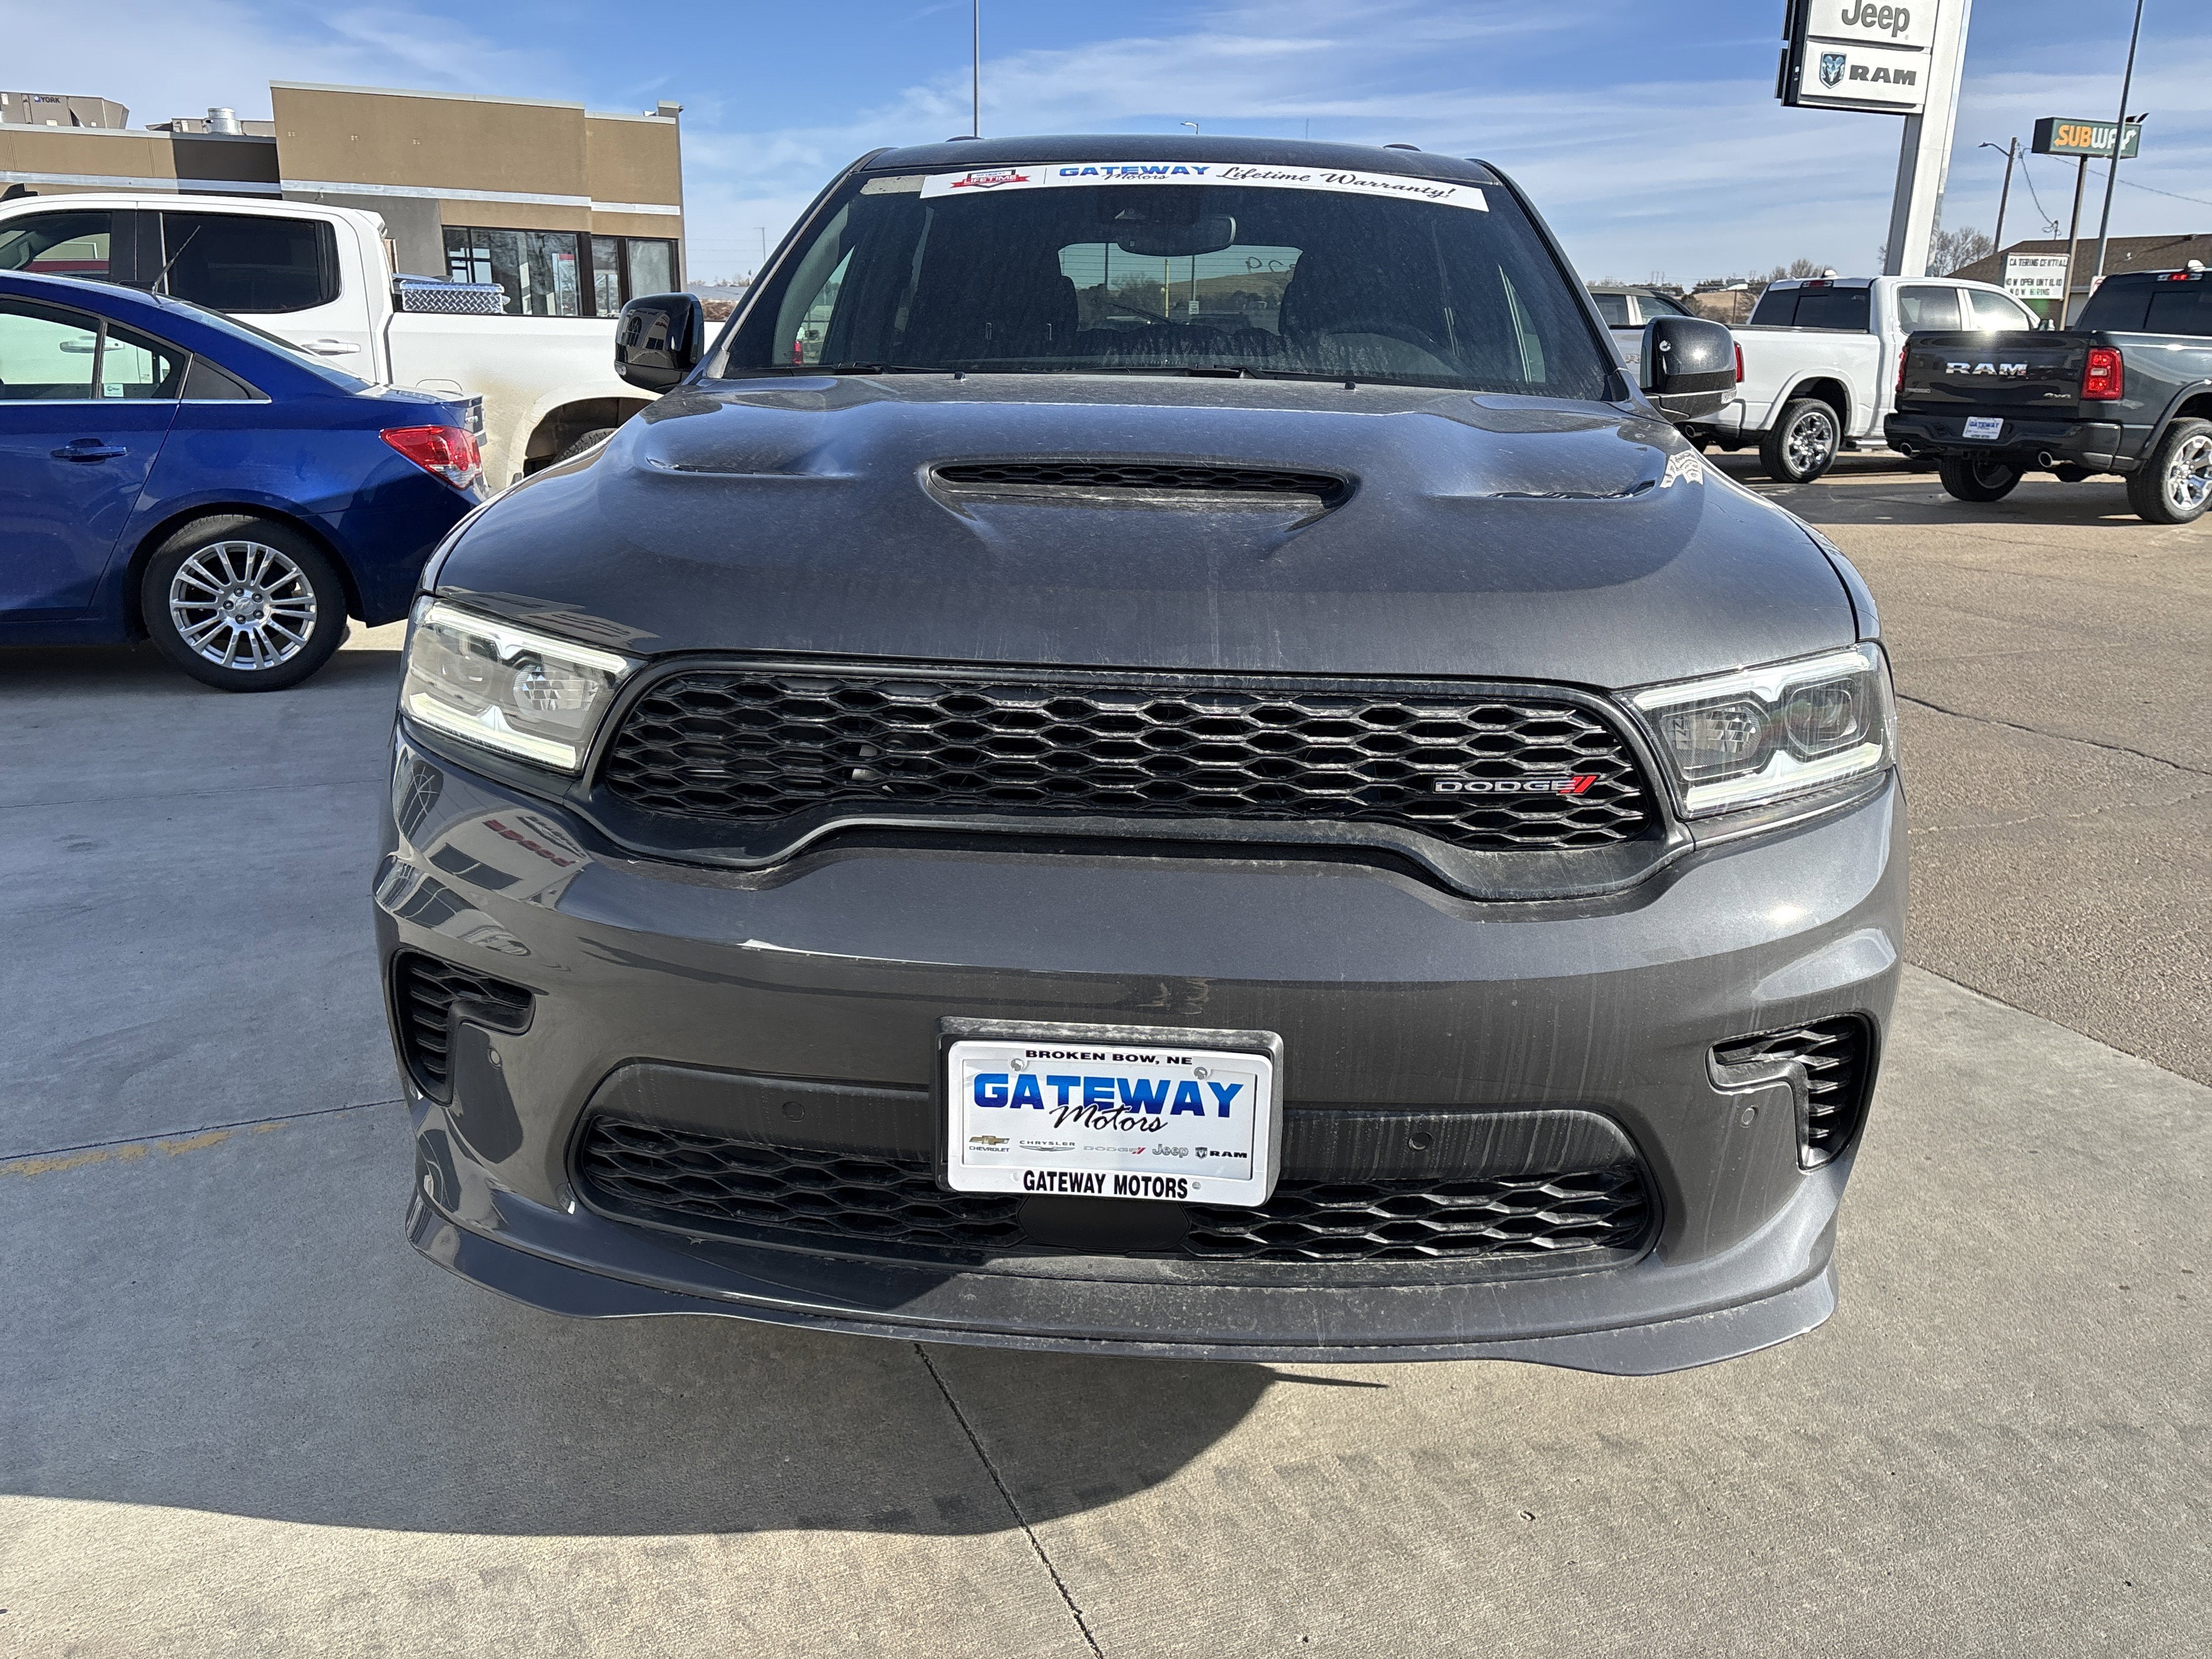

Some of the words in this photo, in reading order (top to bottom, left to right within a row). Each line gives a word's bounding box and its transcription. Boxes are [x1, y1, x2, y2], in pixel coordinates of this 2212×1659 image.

[1842, 0, 1910, 37] Jeep
[1849, 65, 1917, 86] RAM
[963, 174, 1017, 184] LIFETIME
[1059, 166, 1210, 177] GATEWAY
[1101, 172, 1169, 180] Motors
[1216, 167, 1310, 182] Lifetime
[1319, 173, 1457, 198] Warranty!
[1945, 362, 2028, 376] RAM
[1435, 780, 1576, 792] DODGE
[1025, 1049, 1105, 1060] BROKEN
[1113, 1053, 1160, 1064] BOW,
[1167, 1056, 1192, 1065] NE
[974, 1073, 1244, 1118] GATEWAY
[1049, 1104, 1168, 1131] Motors
[1152, 1143, 1189, 1158] Jeep
[1024, 1170, 1107, 1194] GATEWAY
[1114, 1174, 1188, 1199] MOTORS
